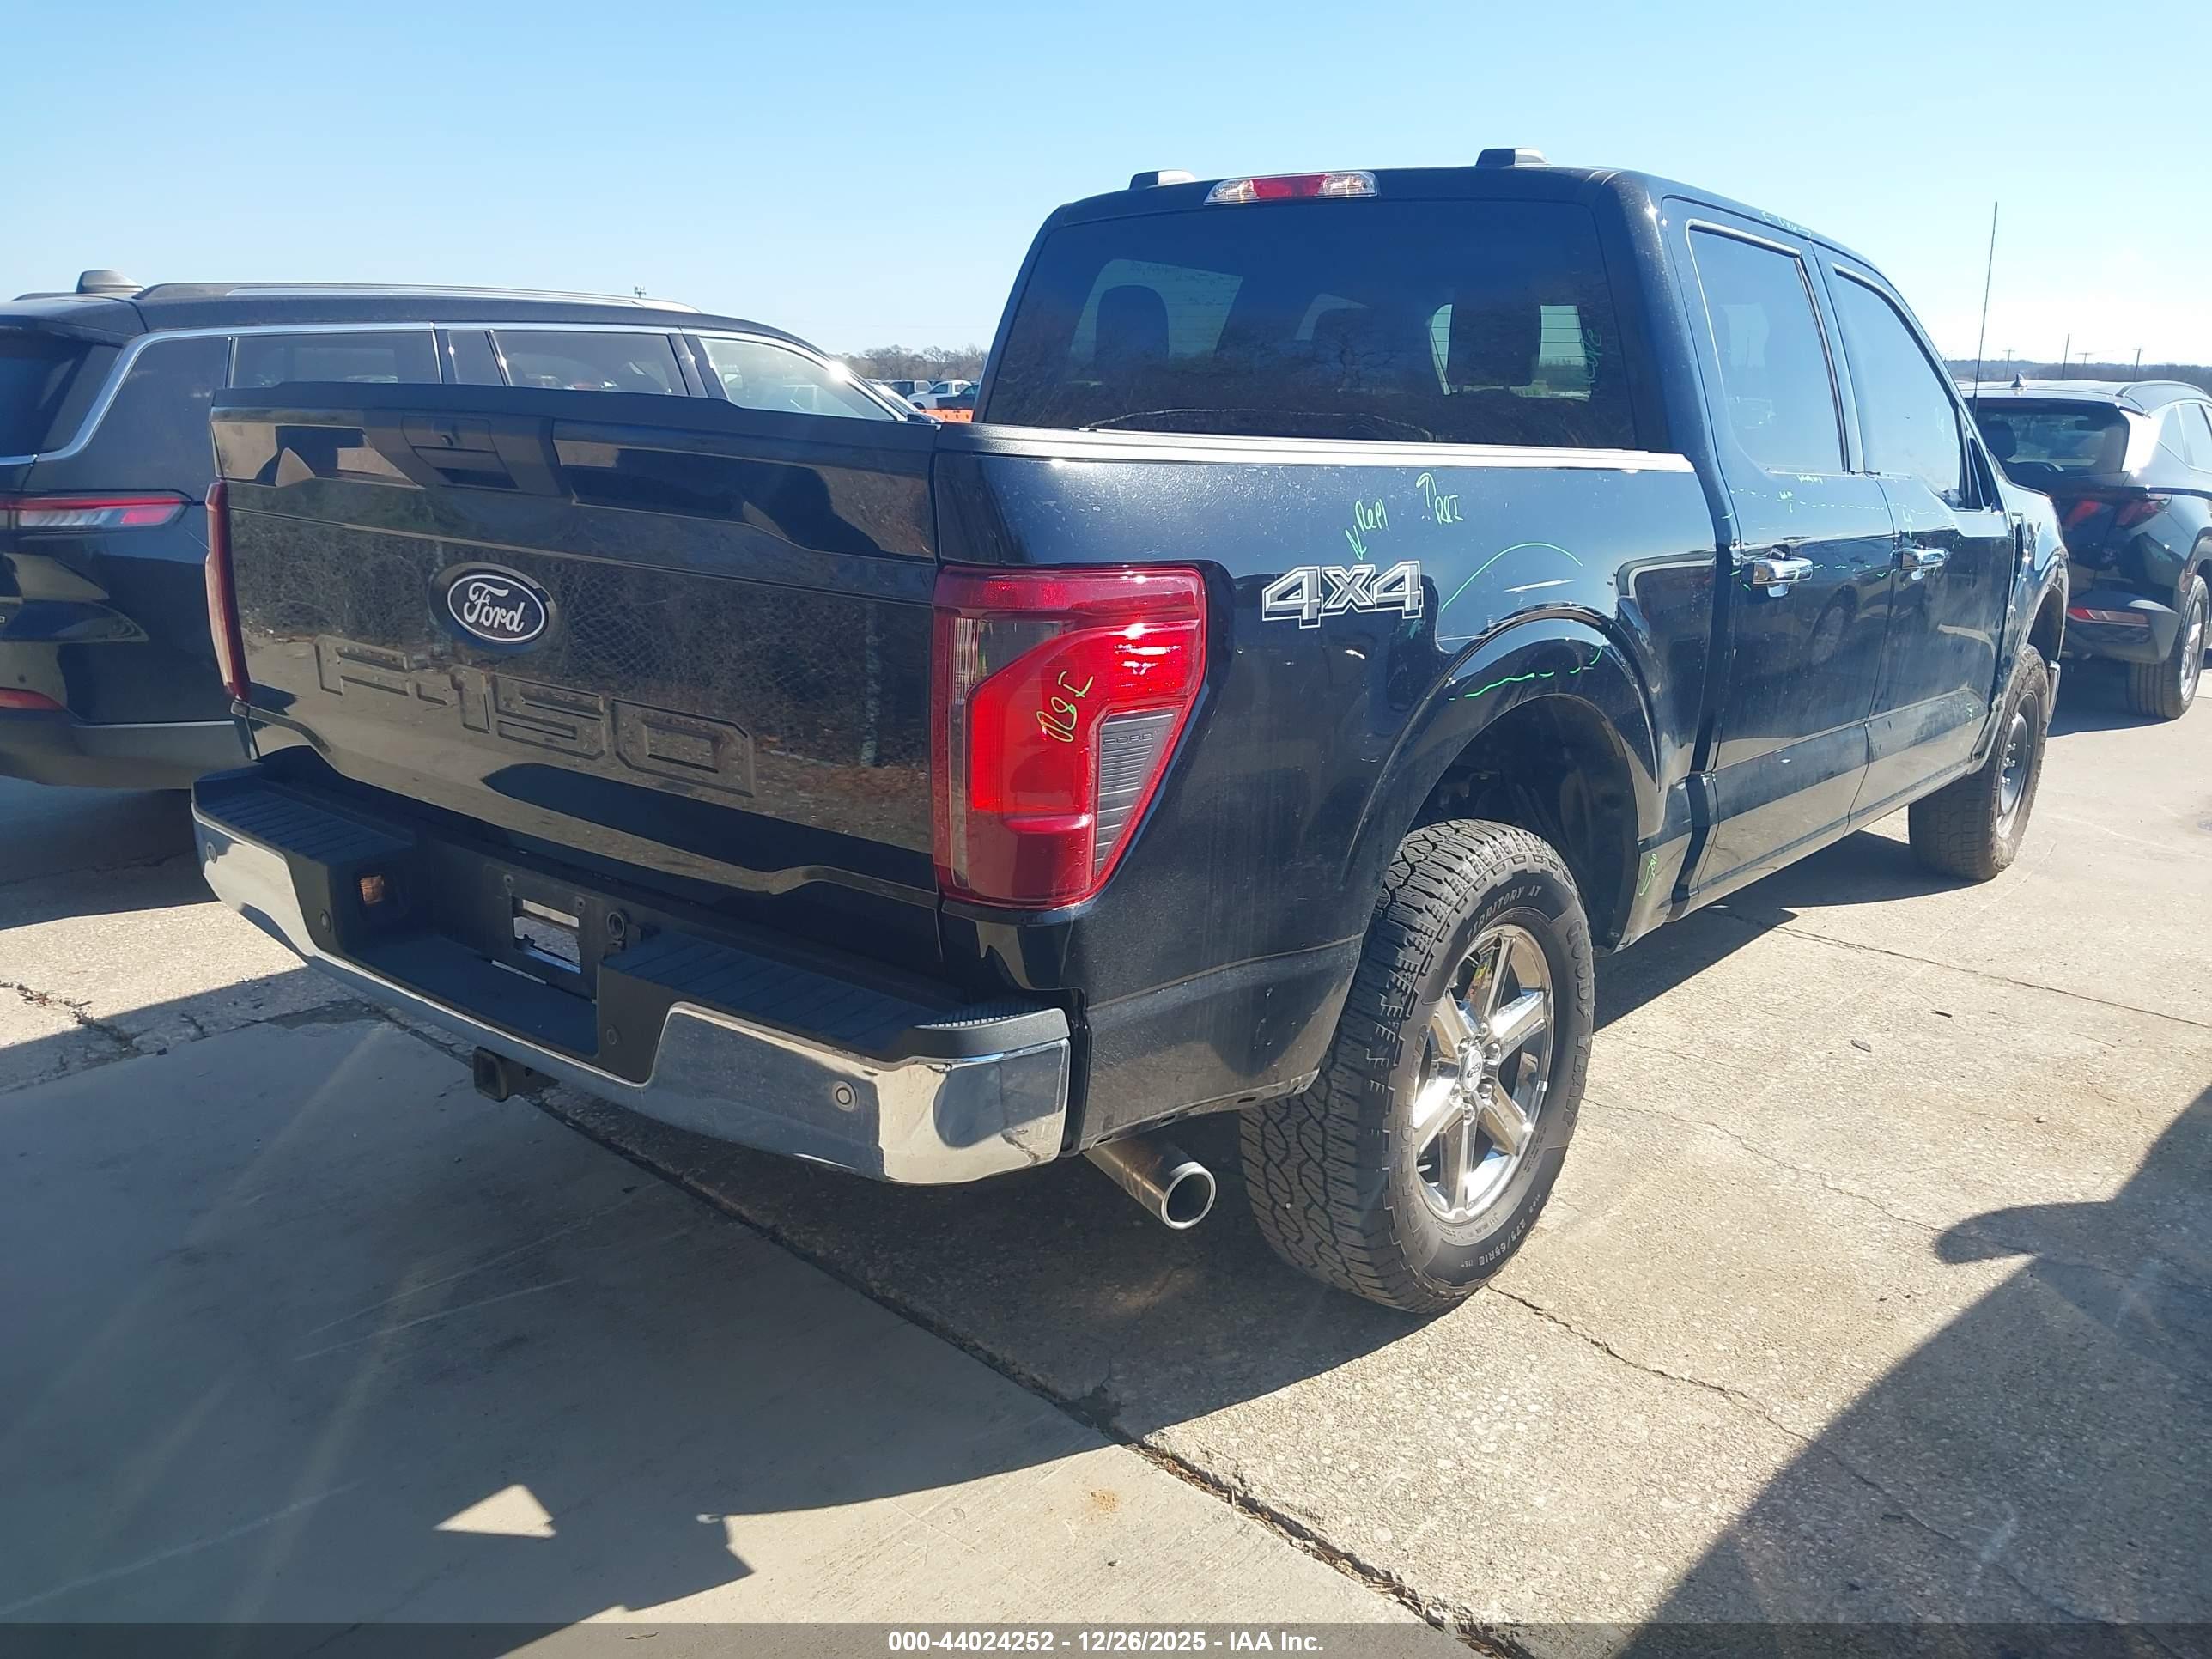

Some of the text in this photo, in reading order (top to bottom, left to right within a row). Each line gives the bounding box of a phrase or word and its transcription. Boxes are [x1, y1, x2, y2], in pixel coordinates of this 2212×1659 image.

[464, 582, 526, 632] Ford
[314, 635, 756, 798] F-150
[1103, 732, 1154, 747] FORD
[1528, 885, 1542, 897] AT
